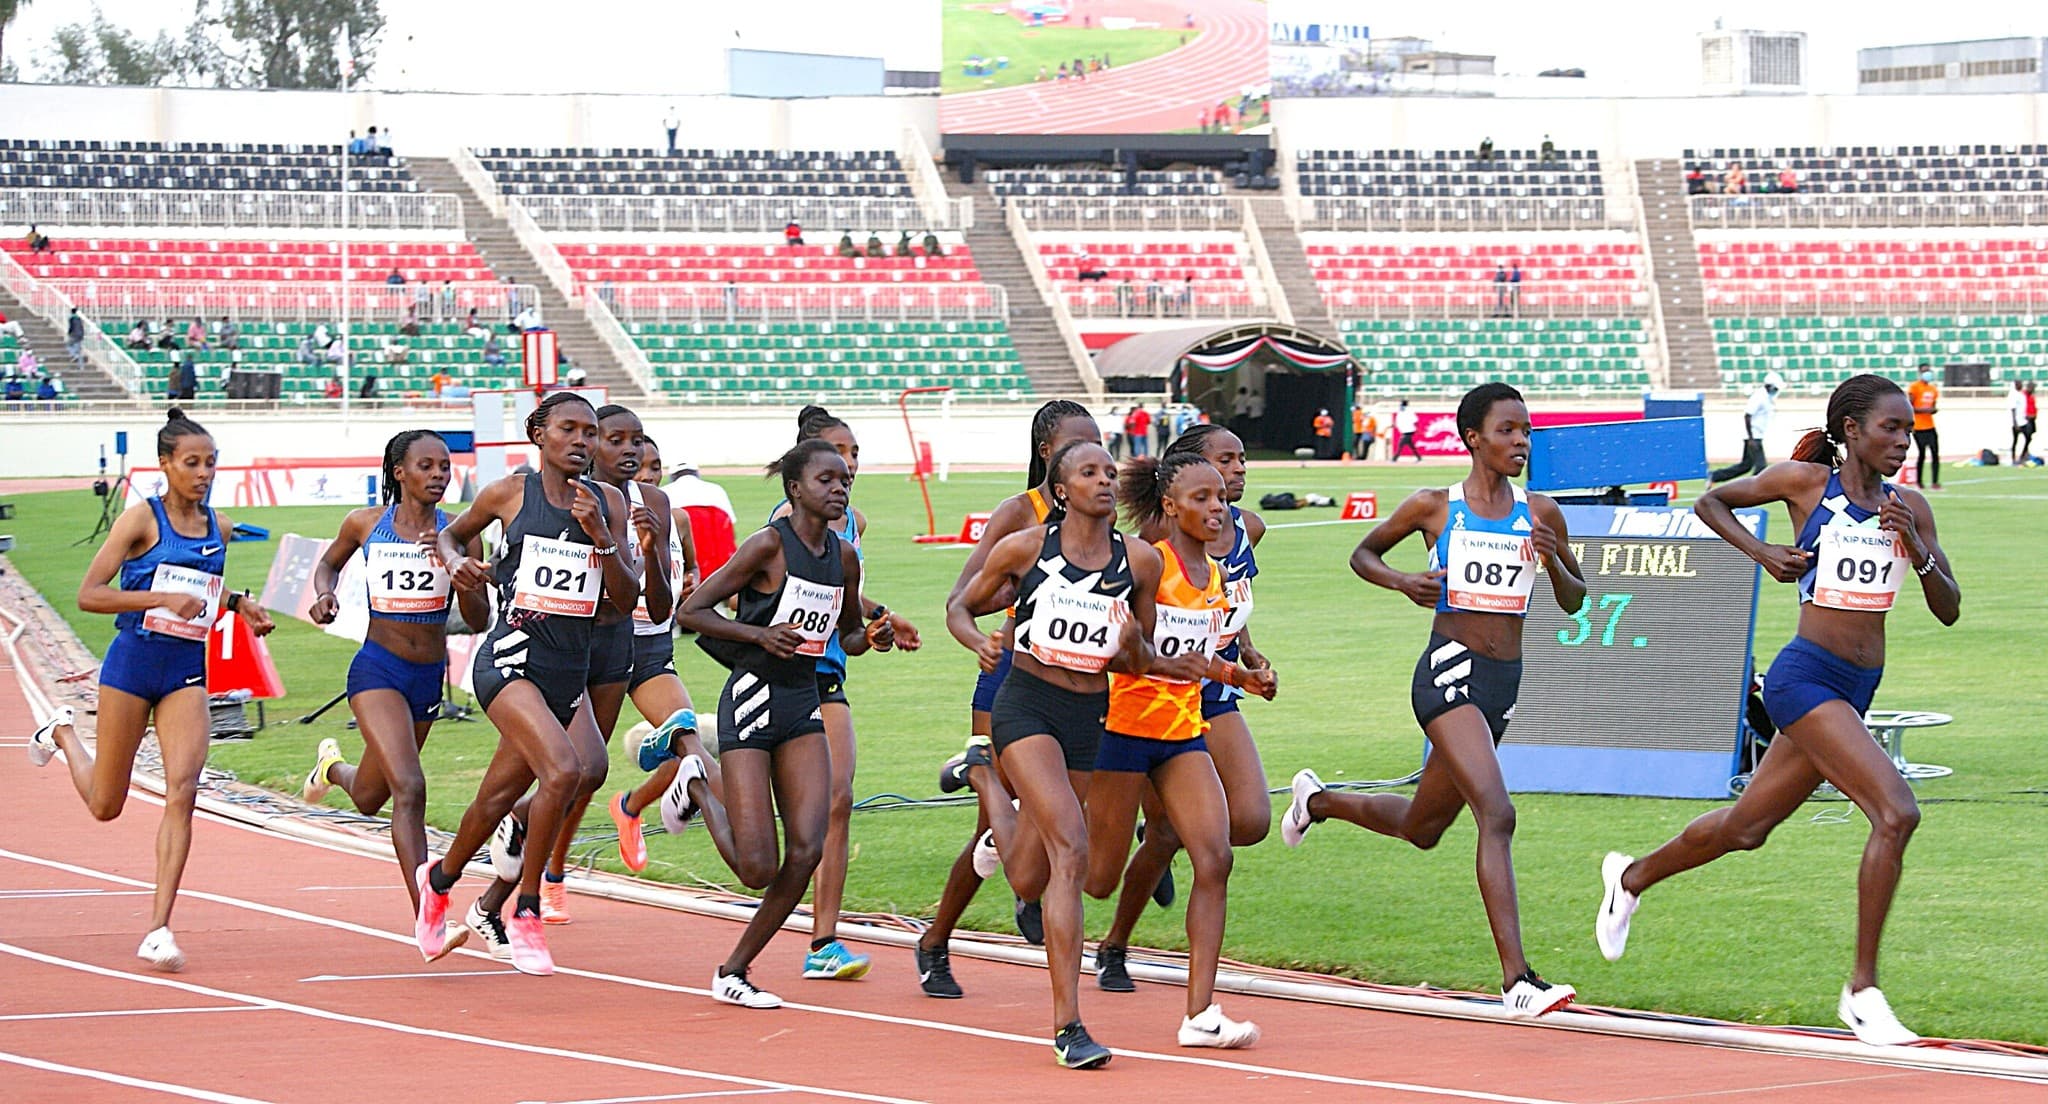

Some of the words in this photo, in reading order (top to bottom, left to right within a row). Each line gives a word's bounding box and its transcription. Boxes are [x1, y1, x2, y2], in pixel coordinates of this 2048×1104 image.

[1350, 500, 1374, 518] 70
[1470, 540, 1486, 548] KIP
[1488, 541, 1518, 552] KEINO
[1842, 535, 1859, 543] KIP
[1861, 536, 1892, 547] KEINO
[542, 546, 557, 555] KIP
[560, 549, 587, 560] KEINO
[1599, 544, 1697, 577] FINAL
[381, 570, 434, 592] 132
[534, 566, 587, 593] 021
[1464, 561, 1523, 587] 087
[1836, 558, 1893, 584] 091
[789, 608, 831, 633] 088
[1170, 615, 1187, 624] KIP
[215, 610, 235, 660] 1
[1049, 618, 1108, 648] 004
[1160, 636, 1208, 657] 034
